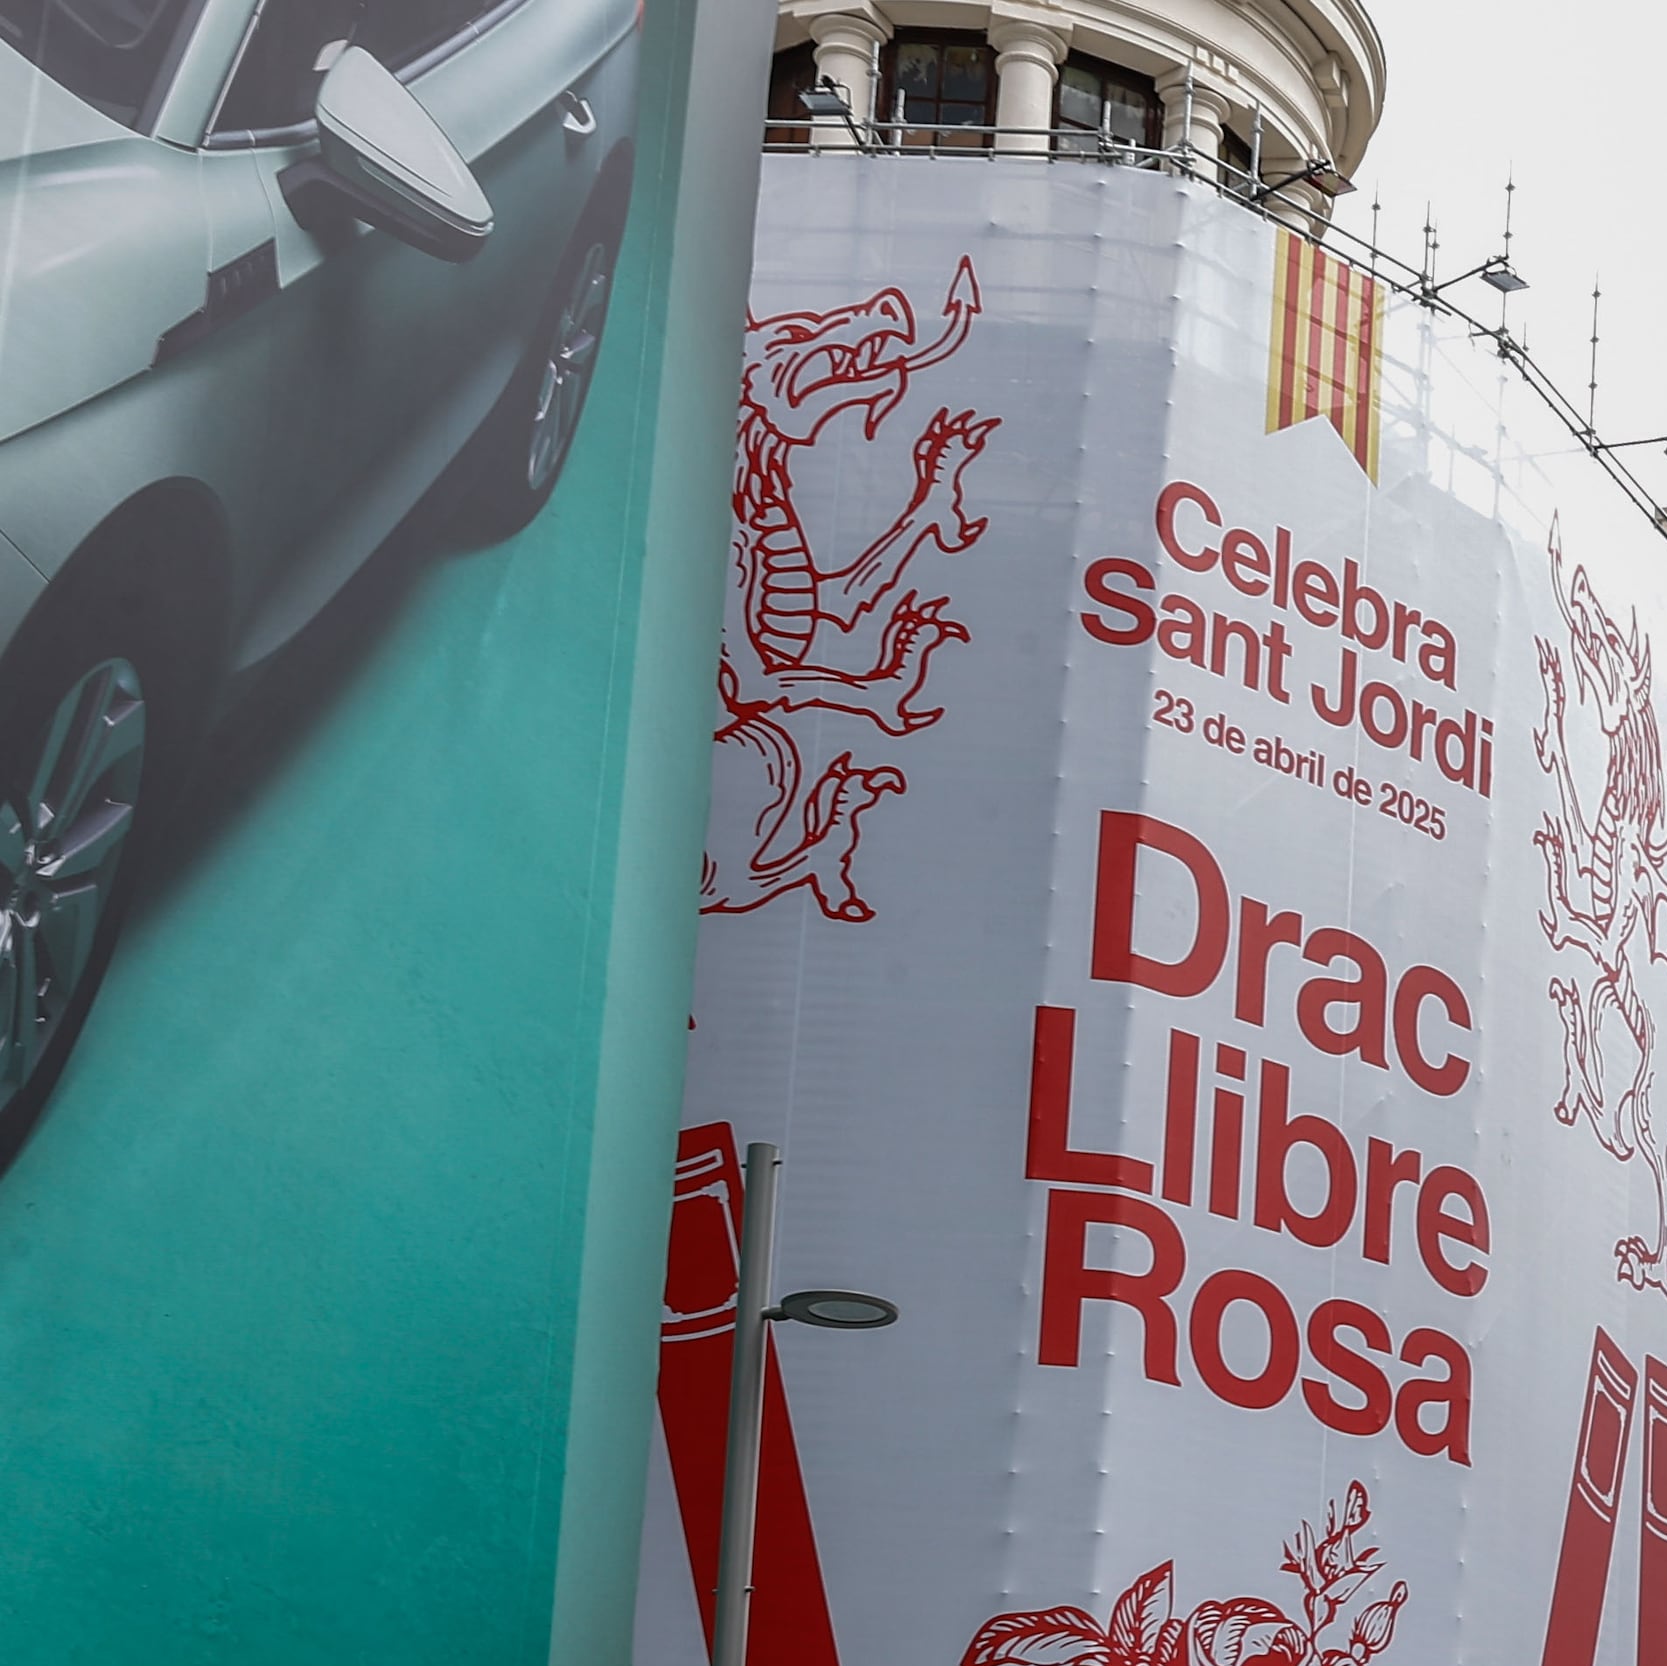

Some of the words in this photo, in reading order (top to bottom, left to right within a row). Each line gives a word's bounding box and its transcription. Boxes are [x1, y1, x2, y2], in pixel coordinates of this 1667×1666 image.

[1081, 558, 1292, 704] Sant
[1311, 647, 1494, 798] Jordi
[1156, 481, 1458, 691] Celebra
[1153, 690, 1195, 734] 23
[1203, 713, 1245, 755] de
[1253, 733, 1325, 788] abril
[1333, 767, 1373, 806] de
[1379, 784, 1446, 840] 2025
[1091, 810, 1473, 1097] Drac
[1025, 1006, 1491, 1297] Llibre
[1038, 1189, 1472, 1468] Rosa
